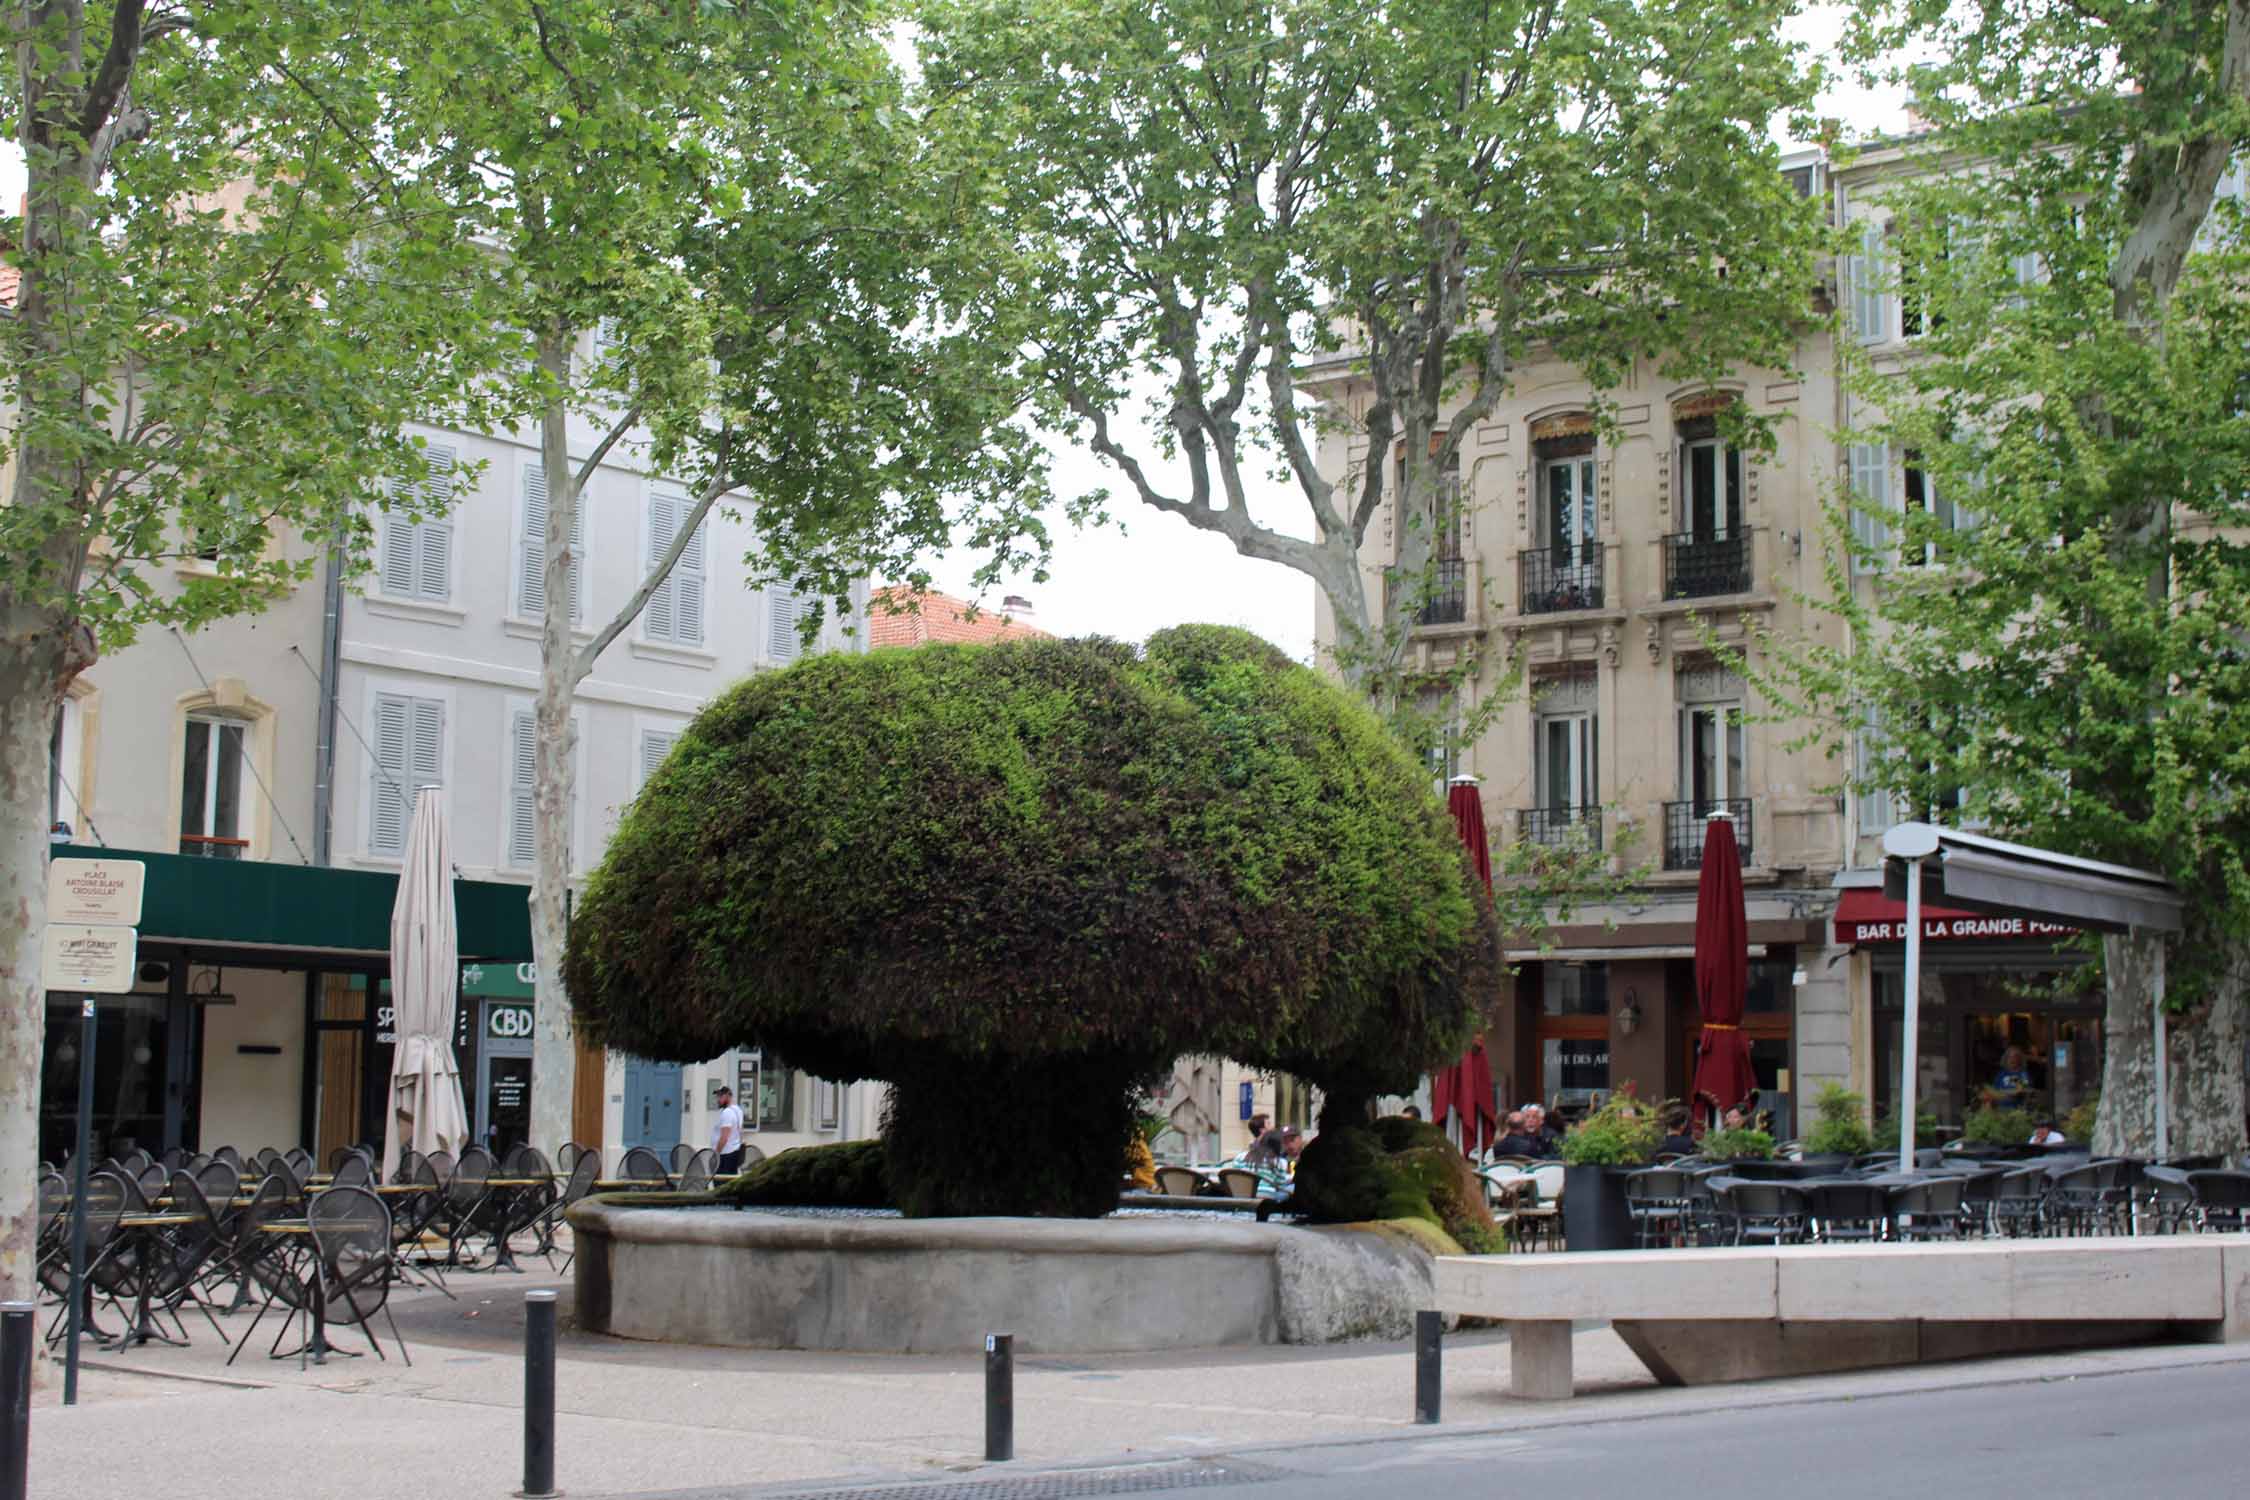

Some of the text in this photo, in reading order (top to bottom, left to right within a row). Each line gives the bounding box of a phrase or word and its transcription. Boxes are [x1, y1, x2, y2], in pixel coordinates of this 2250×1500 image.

[1856, 924, 1891, 940] BAR
[1926, 921, 1948, 937] LA
[1953, 918, 2023, 936] GRANDE
[516, 962, 537, 984] CB
[490, 1008, 533, 1036] CBD
